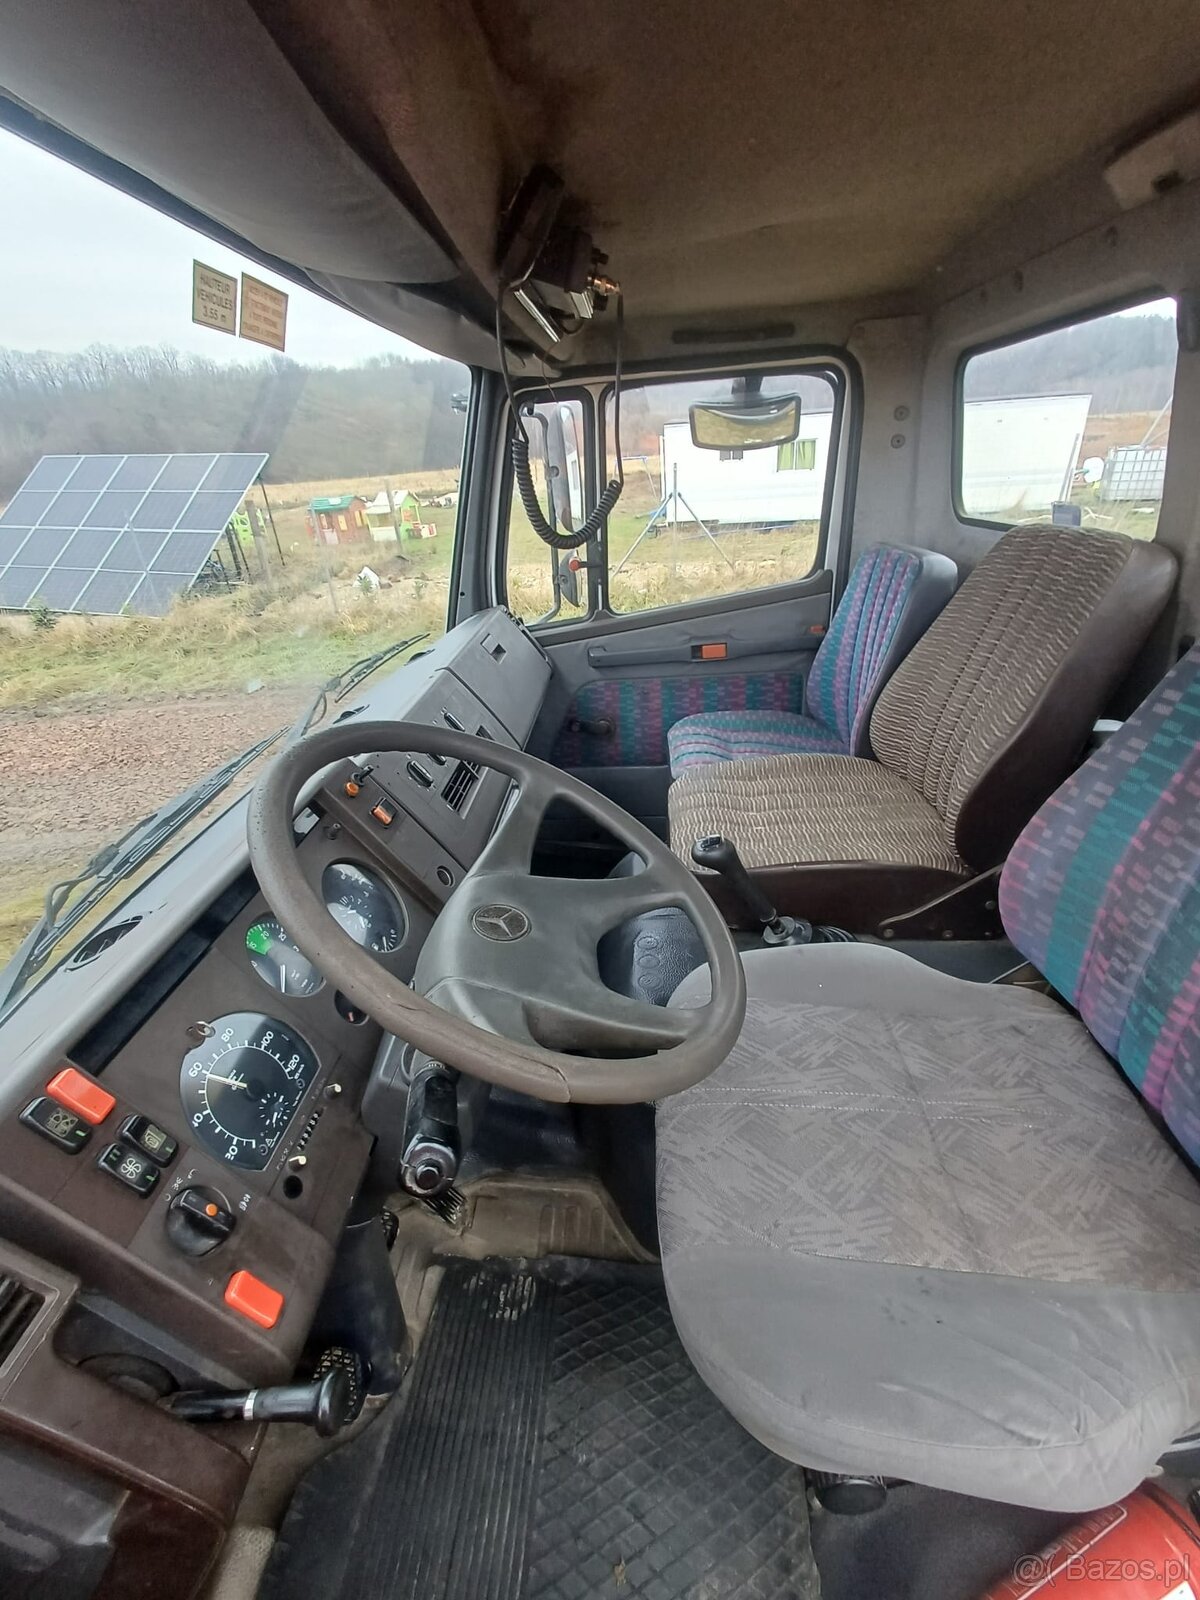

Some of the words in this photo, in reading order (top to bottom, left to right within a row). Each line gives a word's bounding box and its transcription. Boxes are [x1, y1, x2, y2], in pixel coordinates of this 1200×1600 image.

[199, 272, 231, 295] HAUTEUR
[261, 930, 270, 940] 20
[221, 1027, 234, 1043] 80
[261, 1030, 274, 1047] 100
[188, 1062, 203, 1078] 60
[288, 1054, 300, 1070] 120
[192, 1113, 204, 1128] 40
[224, 1145, 238, 1161] 20
